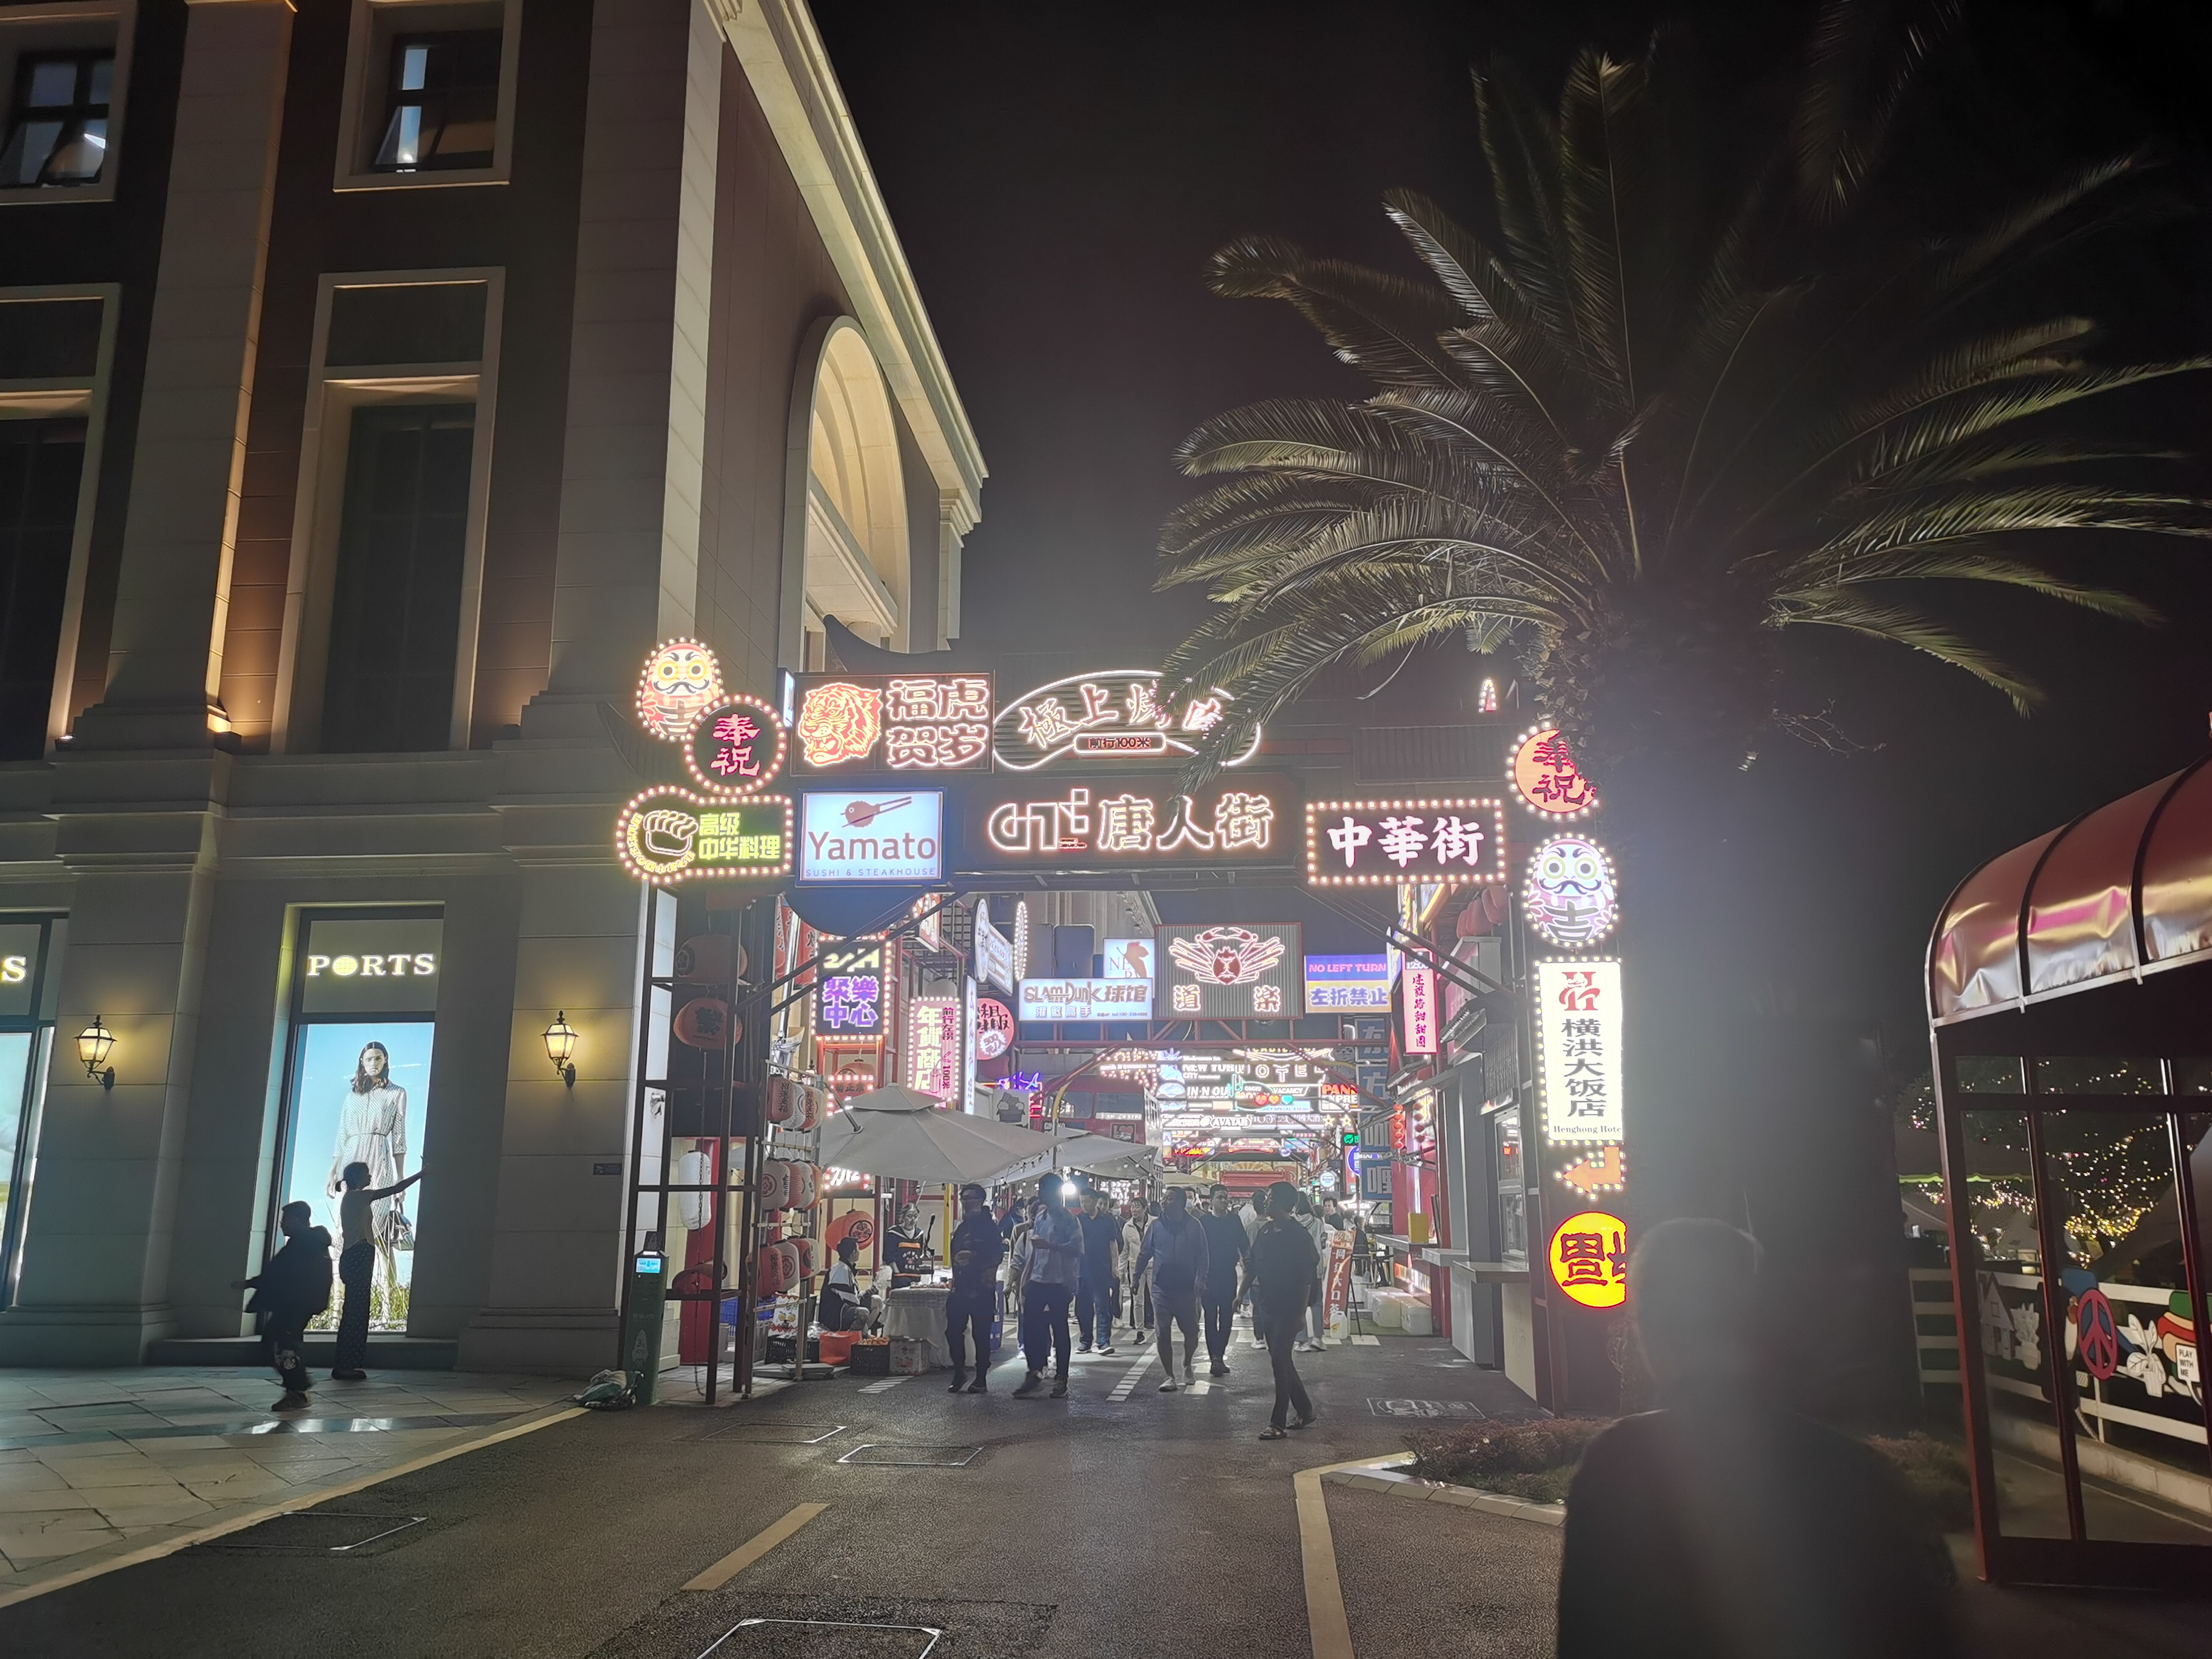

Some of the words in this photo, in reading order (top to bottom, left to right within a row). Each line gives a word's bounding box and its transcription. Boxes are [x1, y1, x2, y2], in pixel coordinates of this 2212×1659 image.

[886, 679, 990, 721] 福虎
[711, 713, 760, 777] 奉祝
[886, 726, 990, 769] 贺岁
[699, 813, 740, 836] 高级
[1097, 793, 1274, 851] 唐人街
[699, 837, 781, 860] 中华料理
[808, 831, 936, 861] Yamato
[1326, 816, 1485, 868] 中華街
[858, 868, 935, 876] STEAKHOUSE
[307, 953, 437, 977] PORTS
[1309, 964, 1322, 973] NO
[1327, 964, 1352, 973] LEFT
[1356, 963, 1387, 972] TURN
[1104, 985, 1148, 1003] 球馆
[1310, 987, 1389, 1007] 左折禁止
[823, 1003, 879, 1029] 中心
[1183, 1064, 1208, 1073] NEW
[1210, 1064, 1235, 1073] YOR
[1561, 1018, 1608, 1118] 横洪大饭店
[1553, 1125, 1598, 1134] Henghong
[2179, 1349, 2193, 1358] PLAY
[2179, 1359, 2194, 1368] WITH
[2180, 1368, 2189, 1378] ME
